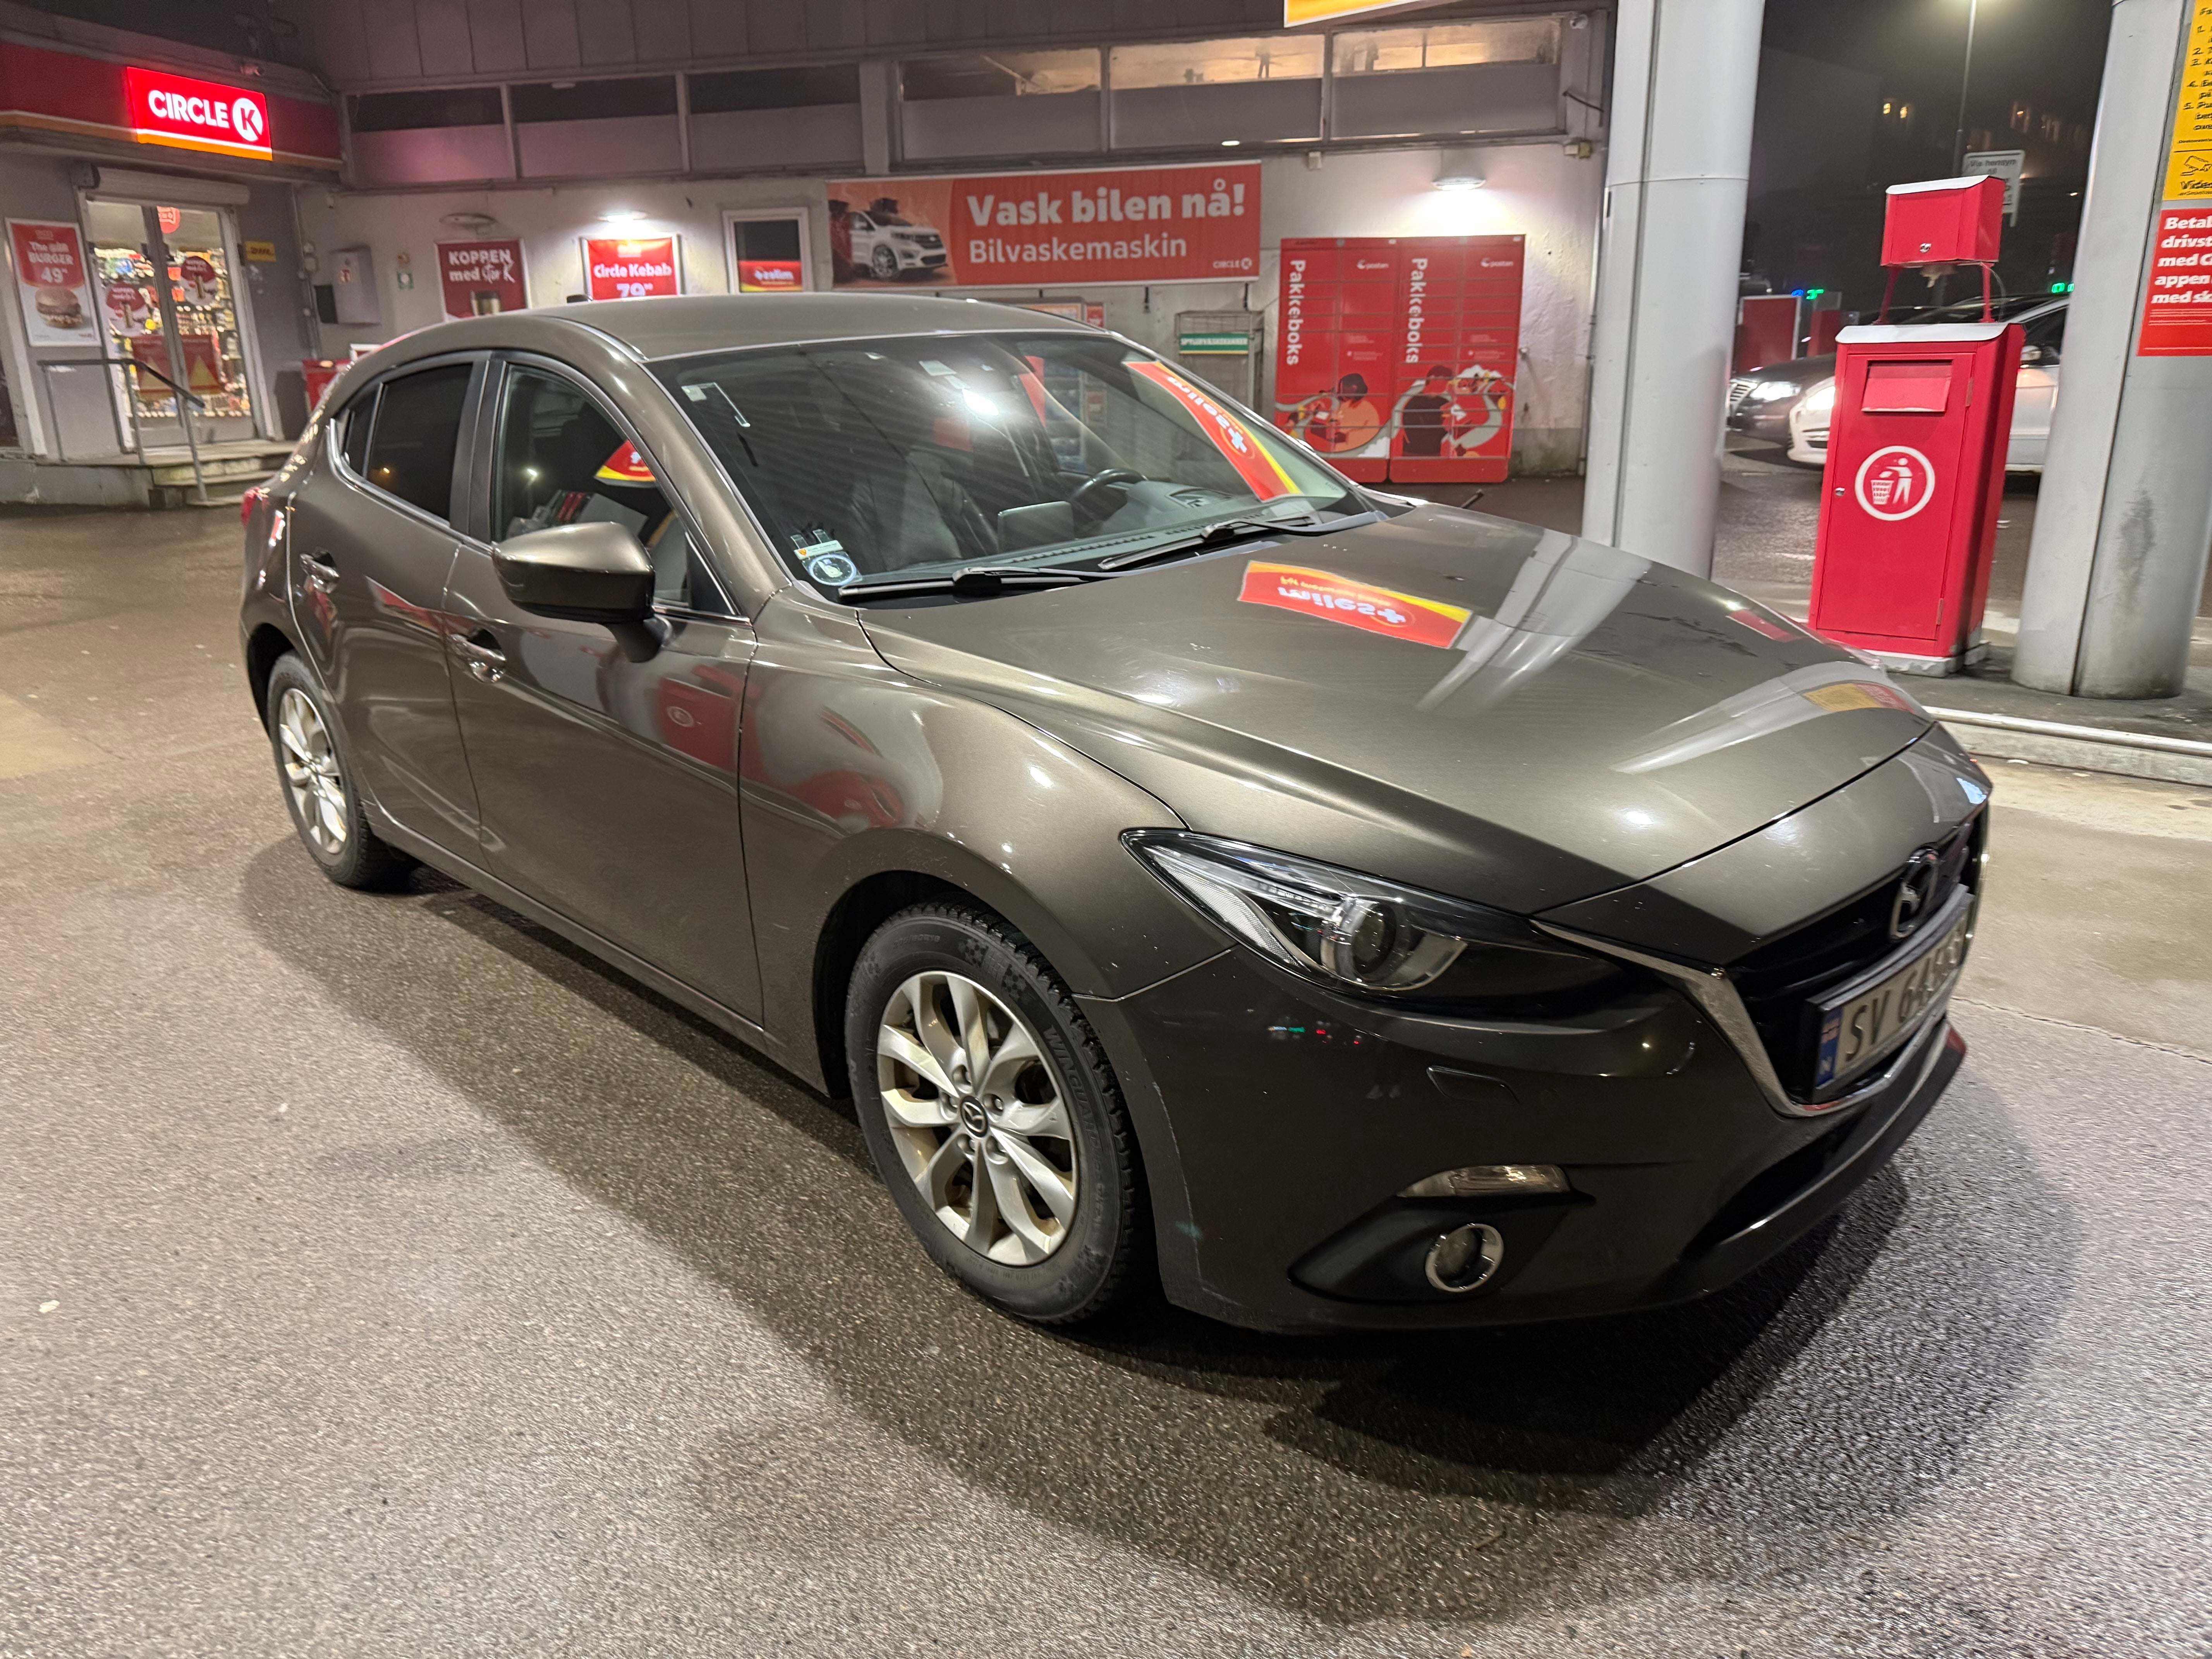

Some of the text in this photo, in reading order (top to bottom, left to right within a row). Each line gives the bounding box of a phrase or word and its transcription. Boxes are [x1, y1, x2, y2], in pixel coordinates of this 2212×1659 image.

[148, 89, 230, 129] CIRCLE
[966, 178, 1245, 227] Vask bilen nå!
[448, 248, 512, 265] KOPPEN
[969, 233, 1187, 264] Bilvaskemaskin
[27, 251, 74, 265] BURGER
[1212, 257, 1252, 270] CIRCLE K
[2157, 253, 2199, 267] med
[41, 266, 64, 283] 49
[449, 266, 481, 282] med
[593, 262, 672, 278] Circle Kebab
[2154, 274, 2211, 288] appen
[2151, 291, 2193, 304] med
[1286, 259, 1306, 366] Pakkeboks
[1405, 258, 1428, 364] Pakkeboks
[1846, 990, 1890, 1062] SV
[1044, 1025, 1101, 1150] WINGUARD
